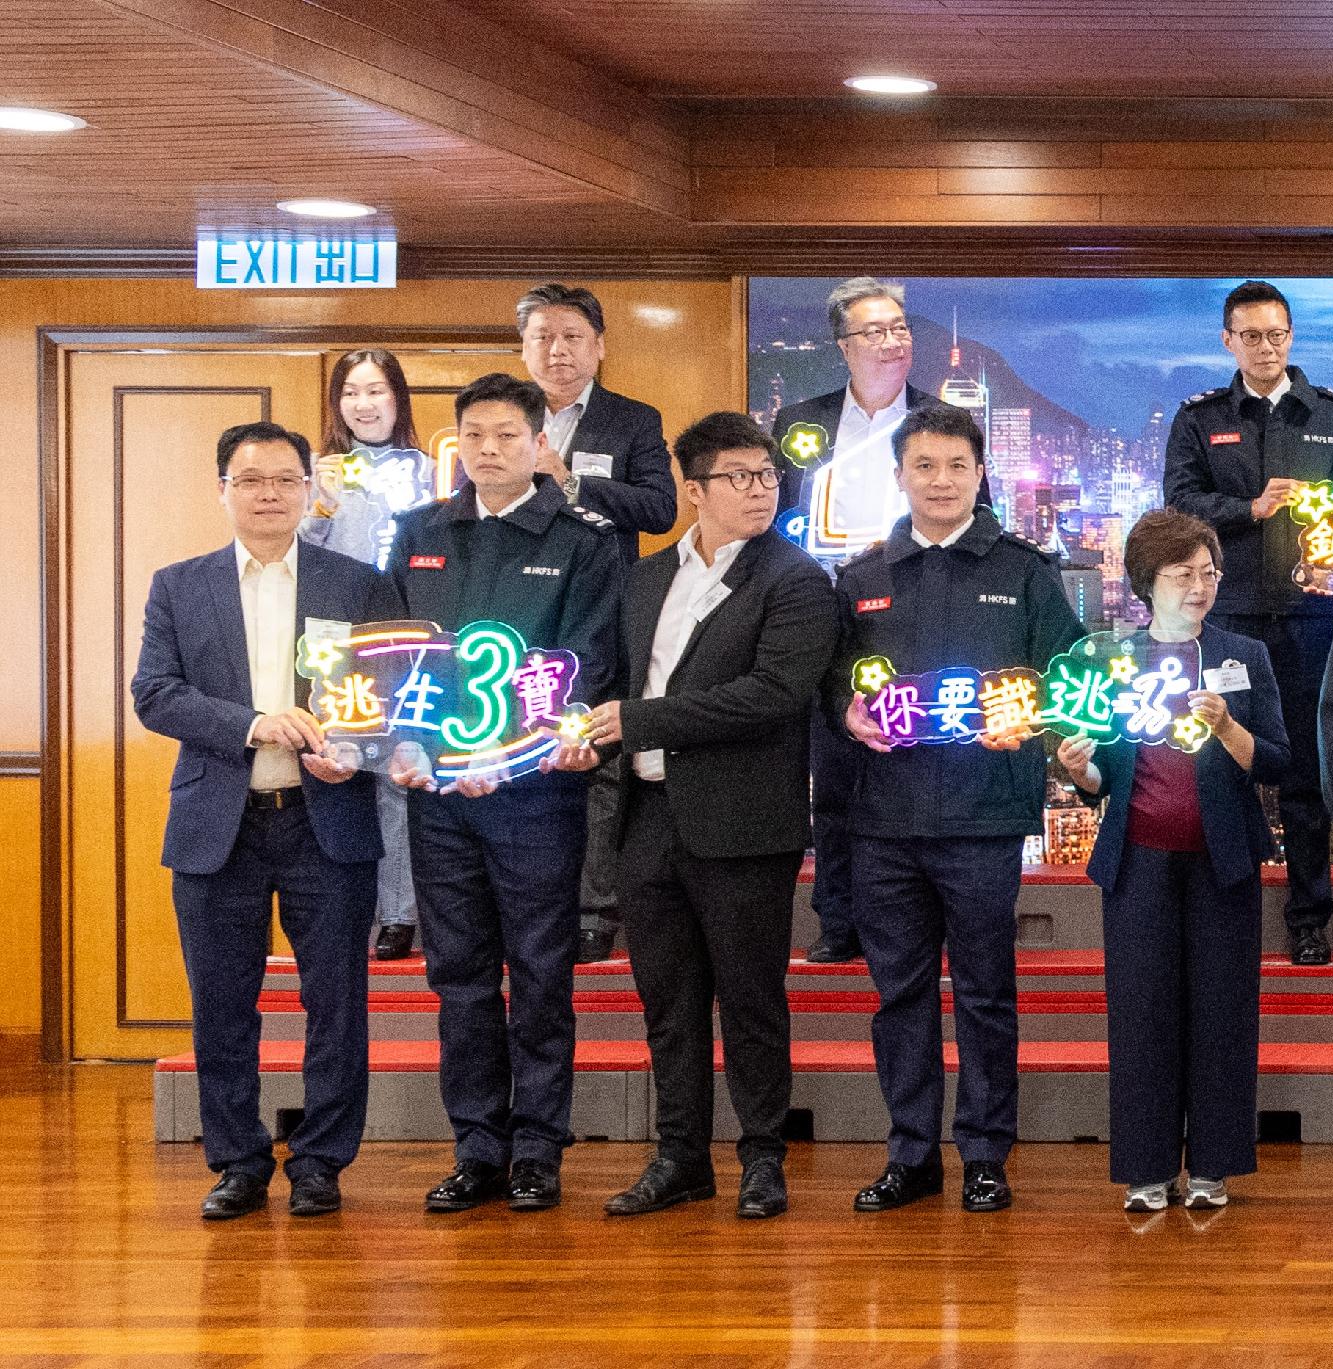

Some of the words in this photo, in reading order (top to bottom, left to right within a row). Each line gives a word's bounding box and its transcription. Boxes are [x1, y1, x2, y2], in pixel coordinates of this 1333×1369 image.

[216, 238, 303, 283] EXIT
[315, 239, 379, 283] 出口
[319, 630, 566, 749] 逃生3寶
[871, 664, 1113, 737] 你要識逃
